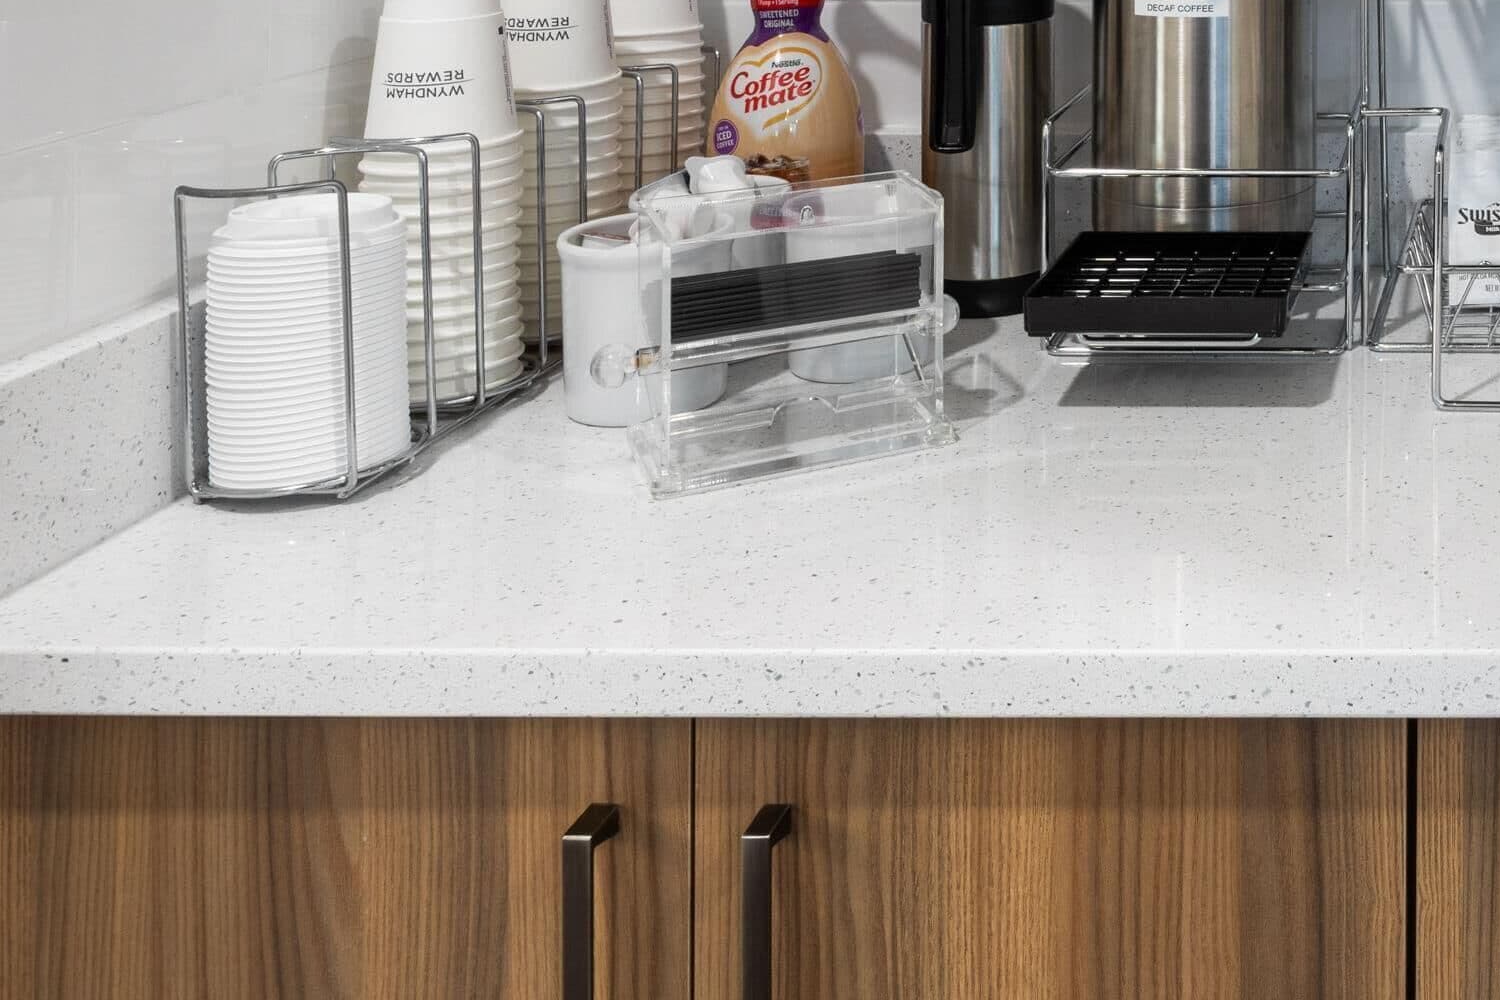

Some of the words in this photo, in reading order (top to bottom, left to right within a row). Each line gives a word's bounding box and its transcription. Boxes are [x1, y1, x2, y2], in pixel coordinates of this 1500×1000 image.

[759, 8, 800, 19] SWEETENED
[1146, 3, 1176, 12] DECAF
[1177, 4, 1215, 13] COFFEE
[504, 16, 570, 28] REWARD
[763, 19, 795, 28] ORIGINAL
[505, 30, 570, 42] WYNDHA
[386, 69, 465, 83] REWARDS
[730, 66, 810, 99] Coffee
[386, 85, 465, 99] WYNDHAM
[744, 80, 813, 114] mate
[716, 130, 732, 142] ICED
